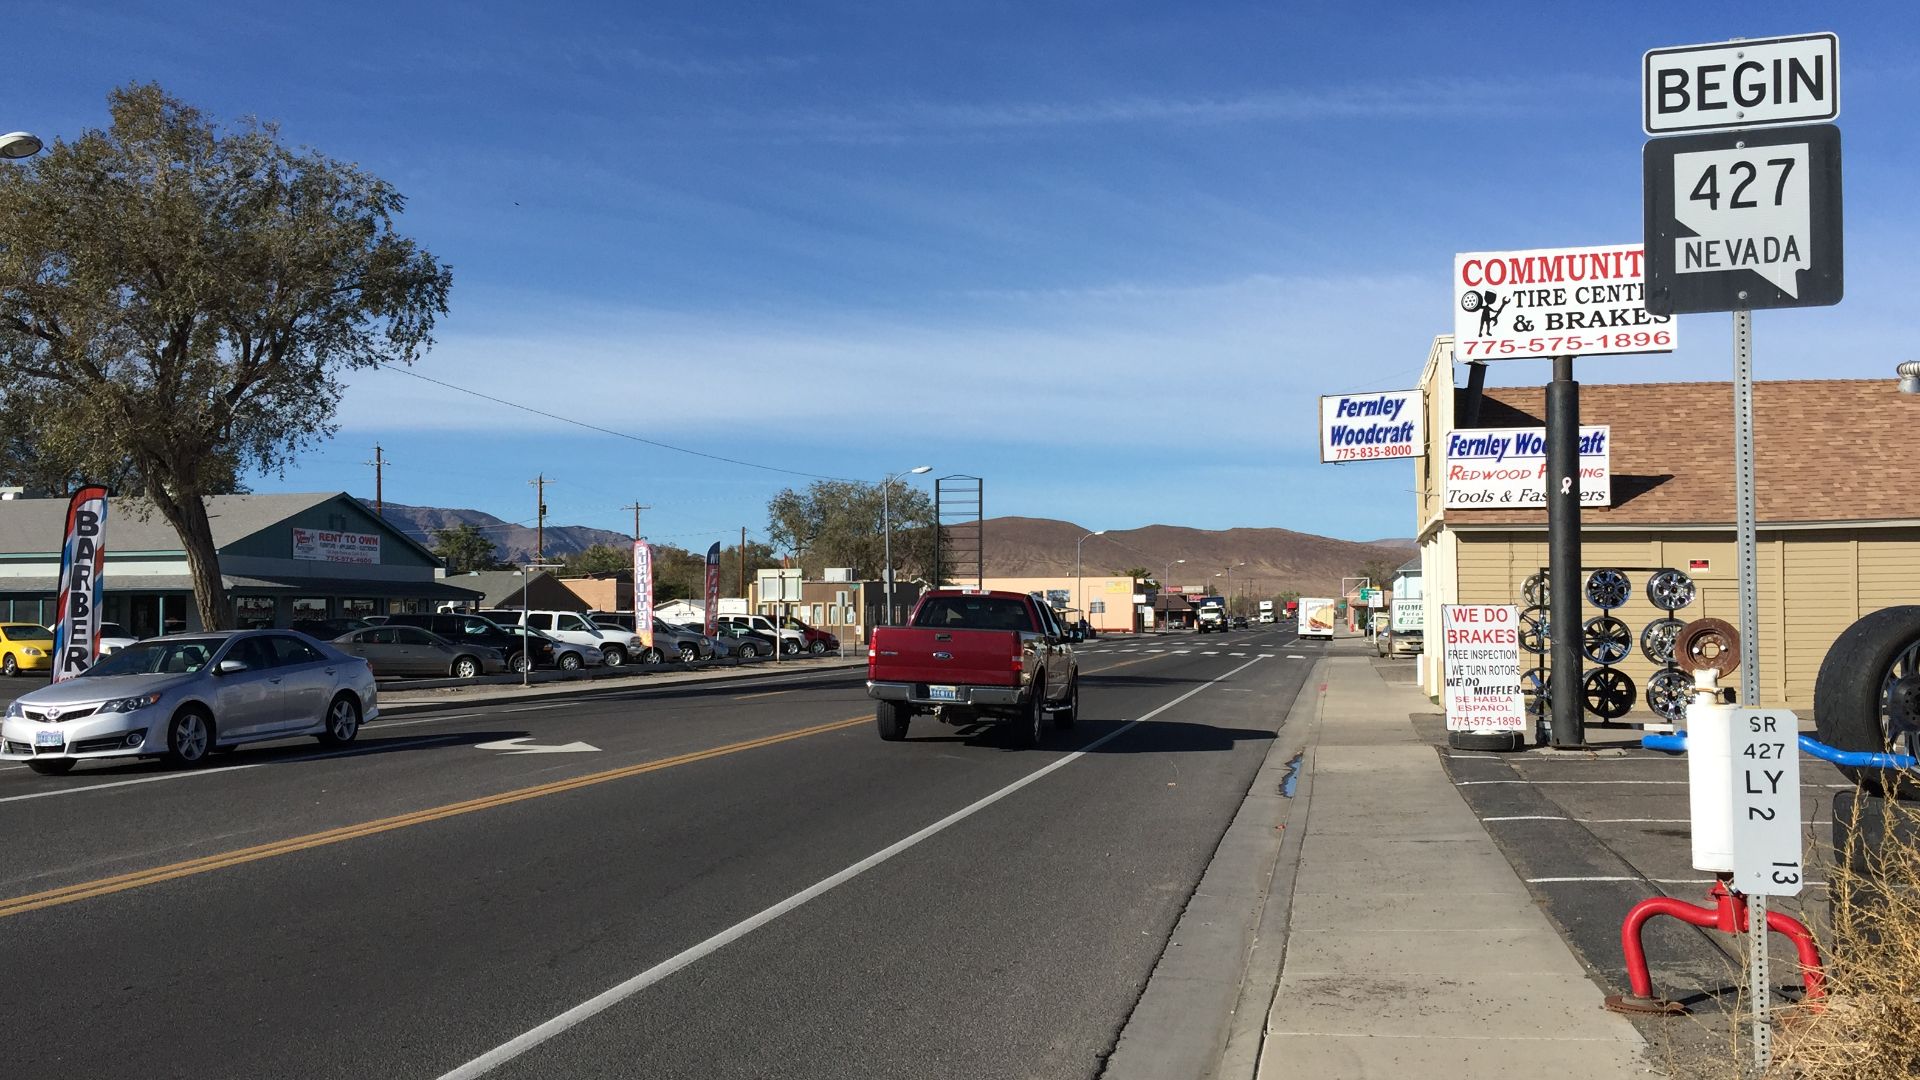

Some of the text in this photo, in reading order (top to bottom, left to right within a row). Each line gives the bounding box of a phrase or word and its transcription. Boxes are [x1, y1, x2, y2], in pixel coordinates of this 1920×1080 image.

[1657, 55, 1824, 114] BEGIN
[1689, 158, 1795, 211] 427
[1685, 235, 1800, 268] NEVADA
[1462, 250, 1643, 287] COMMUNIT
[1512, 283, 1644, 308] TIRE CENT
[1513, 315, 1534, 332] &
[1463, 331, 1671, 355] 775-575-1896
[1336, 395, 1407, 421] Fernley
[1330, 420, 1414, 446] Woodcraft
[1335, 445, 1411, 459] 775-835-8000
[1448, 431, 1605, 462] Fernley Woaft
[1449, 465, 1531, 481] REDWOOD
[1448, 489, 1605, 503] Tools & Fasers
[319, 532, 342, 543] RENT
[345, 535, 356, 543] TO
[359, 536, 378, 546] OWN
[64, 510, 99, 673] BARBER
[1453, 608, 1508, 622] WE DO
[1447, 629, 1516, 644] BRAKES
[1448, 650, 1517, 660] FREE INSPECTION
[1452, 665, 1520, 675] WE TURN ROTORS
[1446, 678, 1480, 687] WE DO
[1473, 685, 1520, 695] MUFFLER
[1473, 695, 1513, 703] HABLA
[1458, 704, 1512, 712] ESPAÑOL
[1451, 717, 1521, 726] 775-575-1896
[1749, 716, 1777, 733] SR
[1743, 743, 1785, 759] 427
[1745, 770, 1784, 794] LY
[1749, 807, 1776, 821] 2
[1772, 861, 1799, 885] 13
